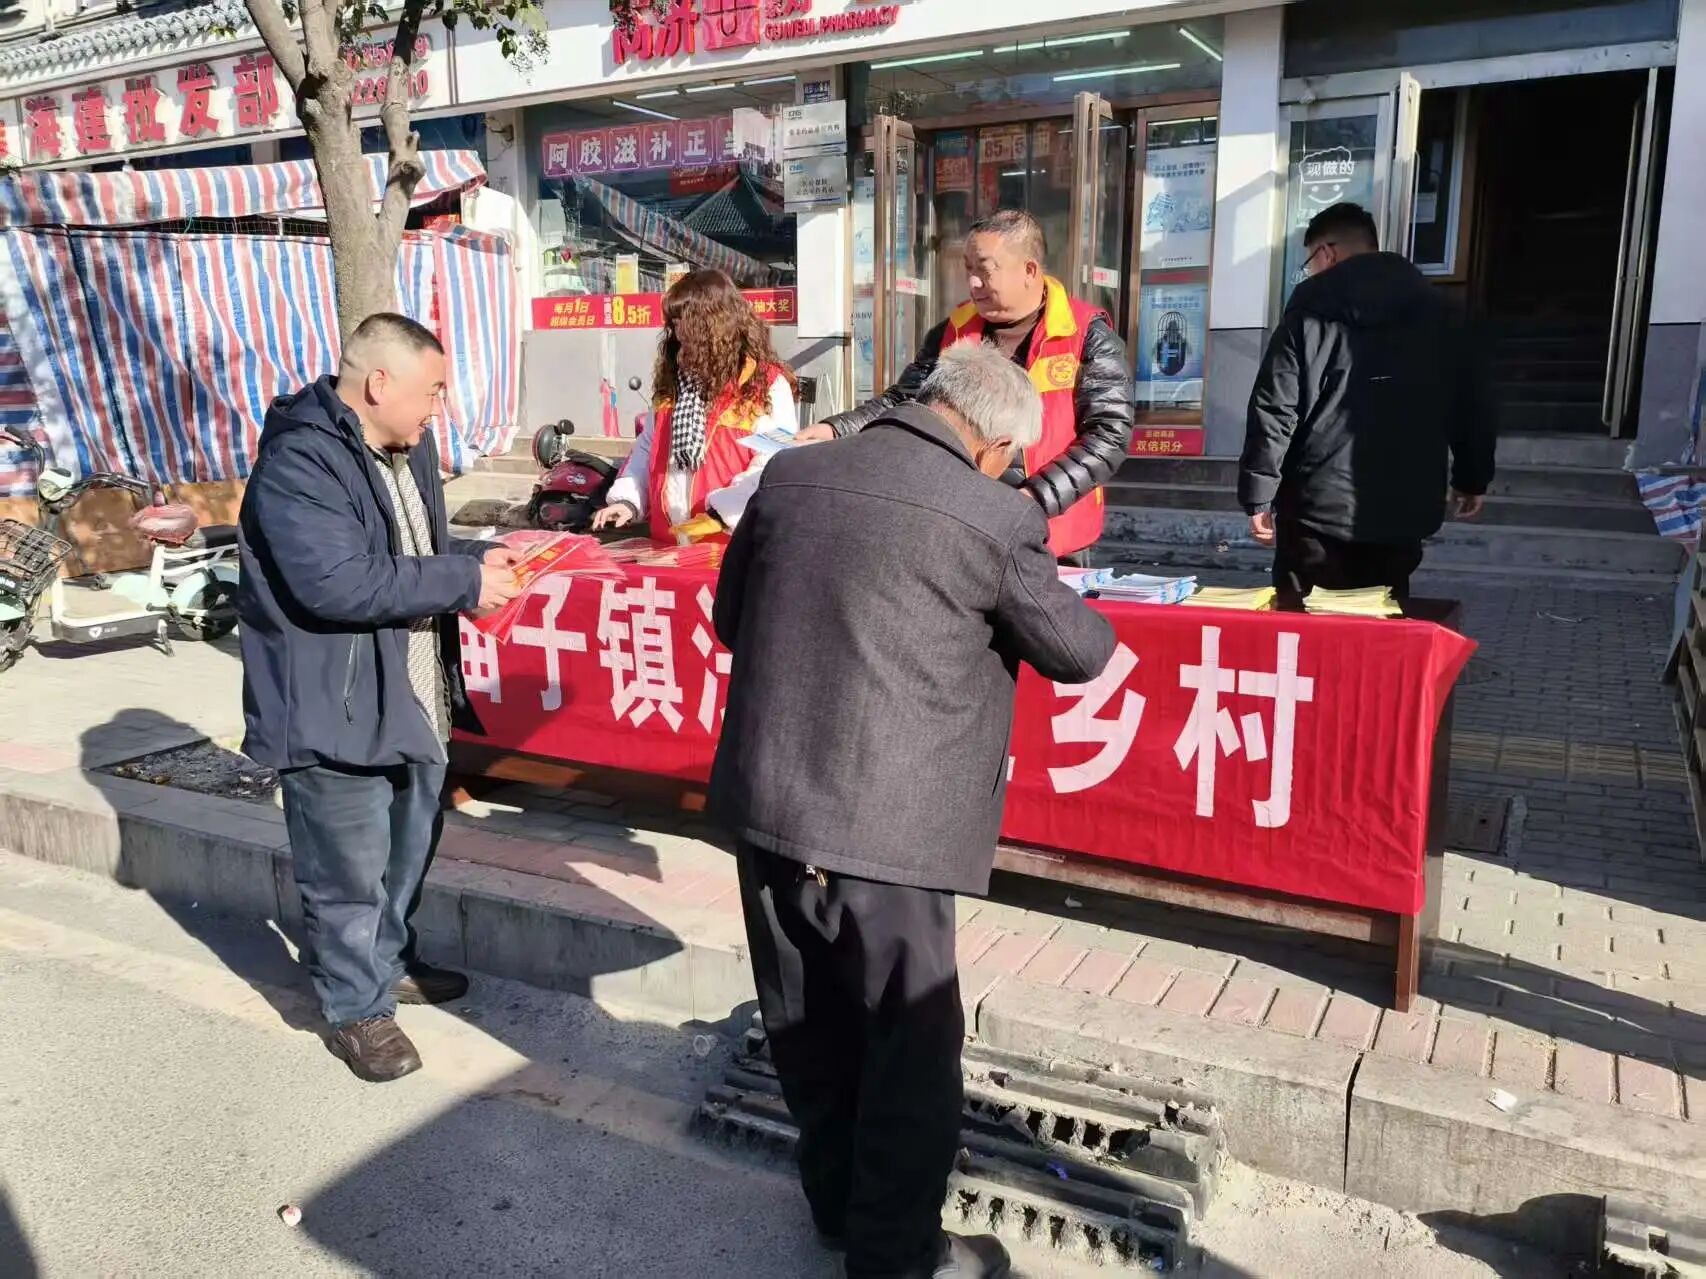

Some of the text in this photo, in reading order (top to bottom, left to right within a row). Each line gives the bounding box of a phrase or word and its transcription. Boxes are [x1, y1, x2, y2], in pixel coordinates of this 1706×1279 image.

[820, 5, 900, 33] PHARMACY
[1306, 160, 1355, 177] 现做的
[612, 296, 652, 325] 8.5折
[1136, 440, 1184, 453] 双倍积分
